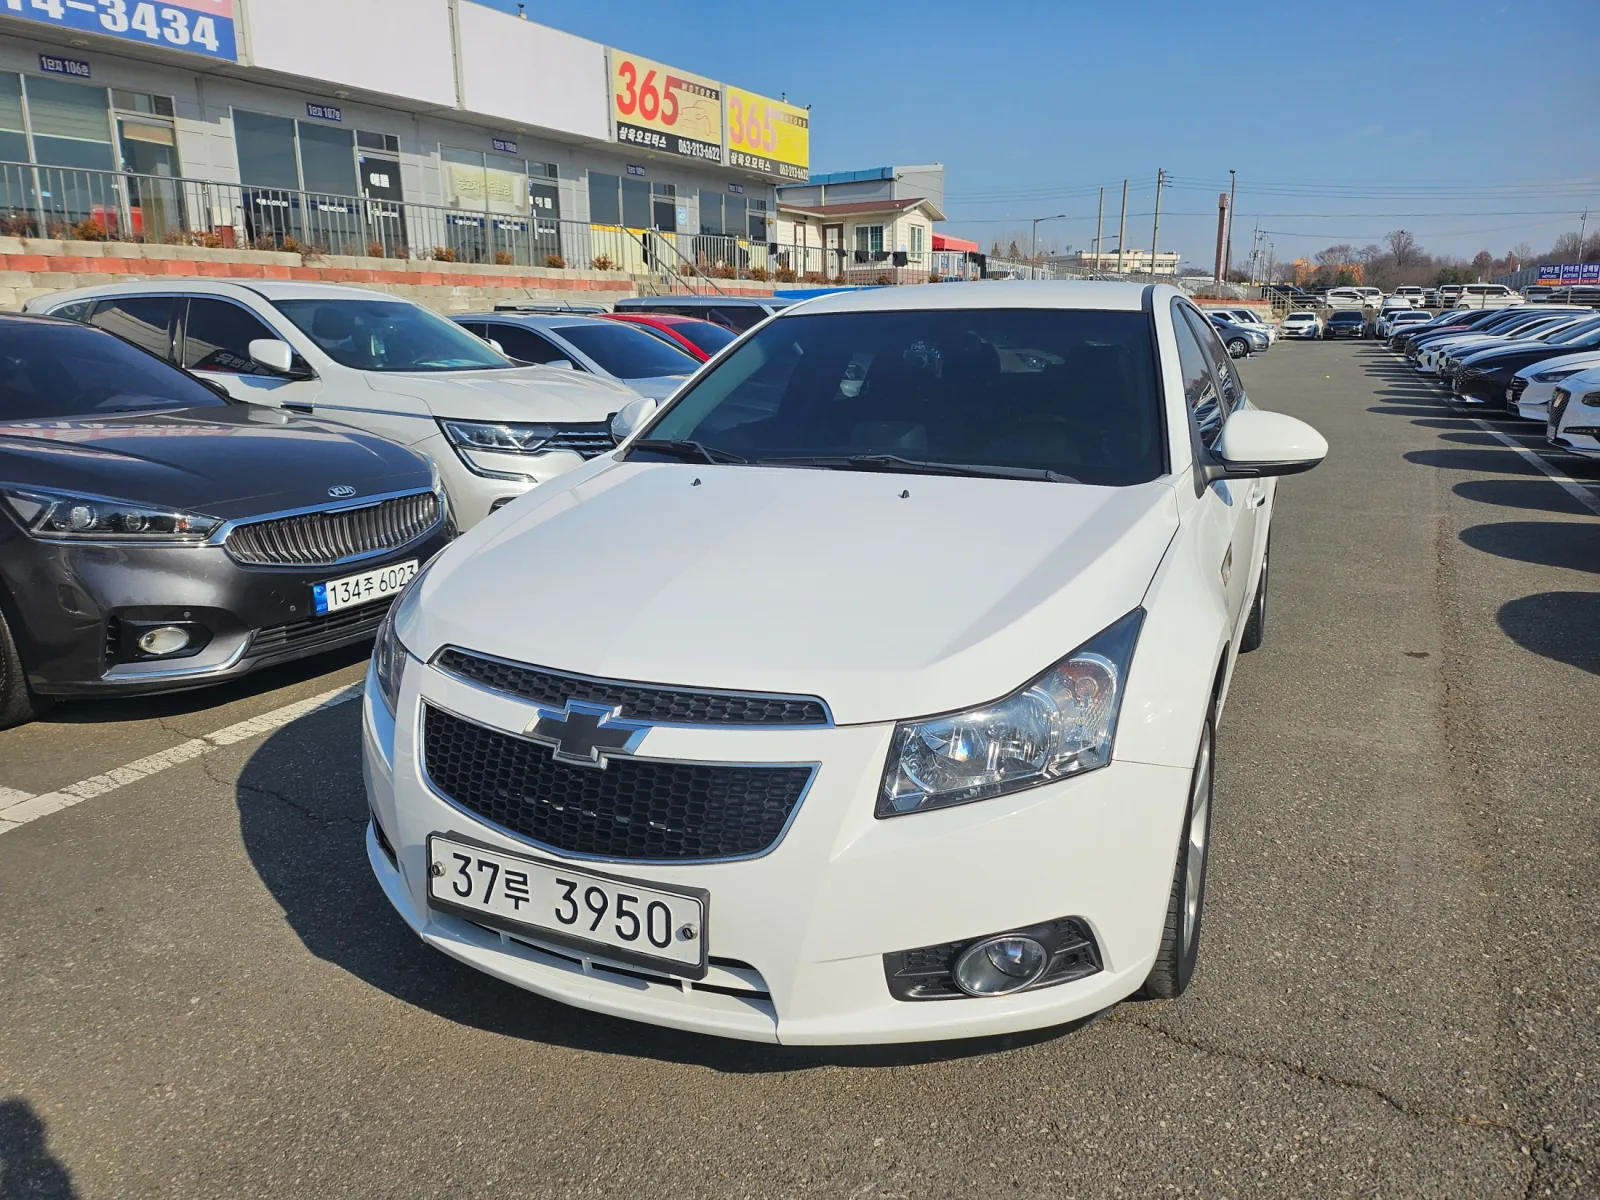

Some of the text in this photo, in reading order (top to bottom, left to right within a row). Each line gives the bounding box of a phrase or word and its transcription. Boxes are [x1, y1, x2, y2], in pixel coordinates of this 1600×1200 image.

[64, 60, 89, 76] 106호
[616, 61, 679, 126] 365
[681, 82, 716, 99] MOTORS
[730, 95, 776, 152] 365
[619, 126, 720, 161] 삼육오모터스 063-213-6622
[730, 152, 808, 181] 삼육오모터스 063-213-6622
[331, 486, 354, 496] KIA
[330, 564, 415, 605] 134주 6023
[452, 851, 672, 948] 37루 3950
